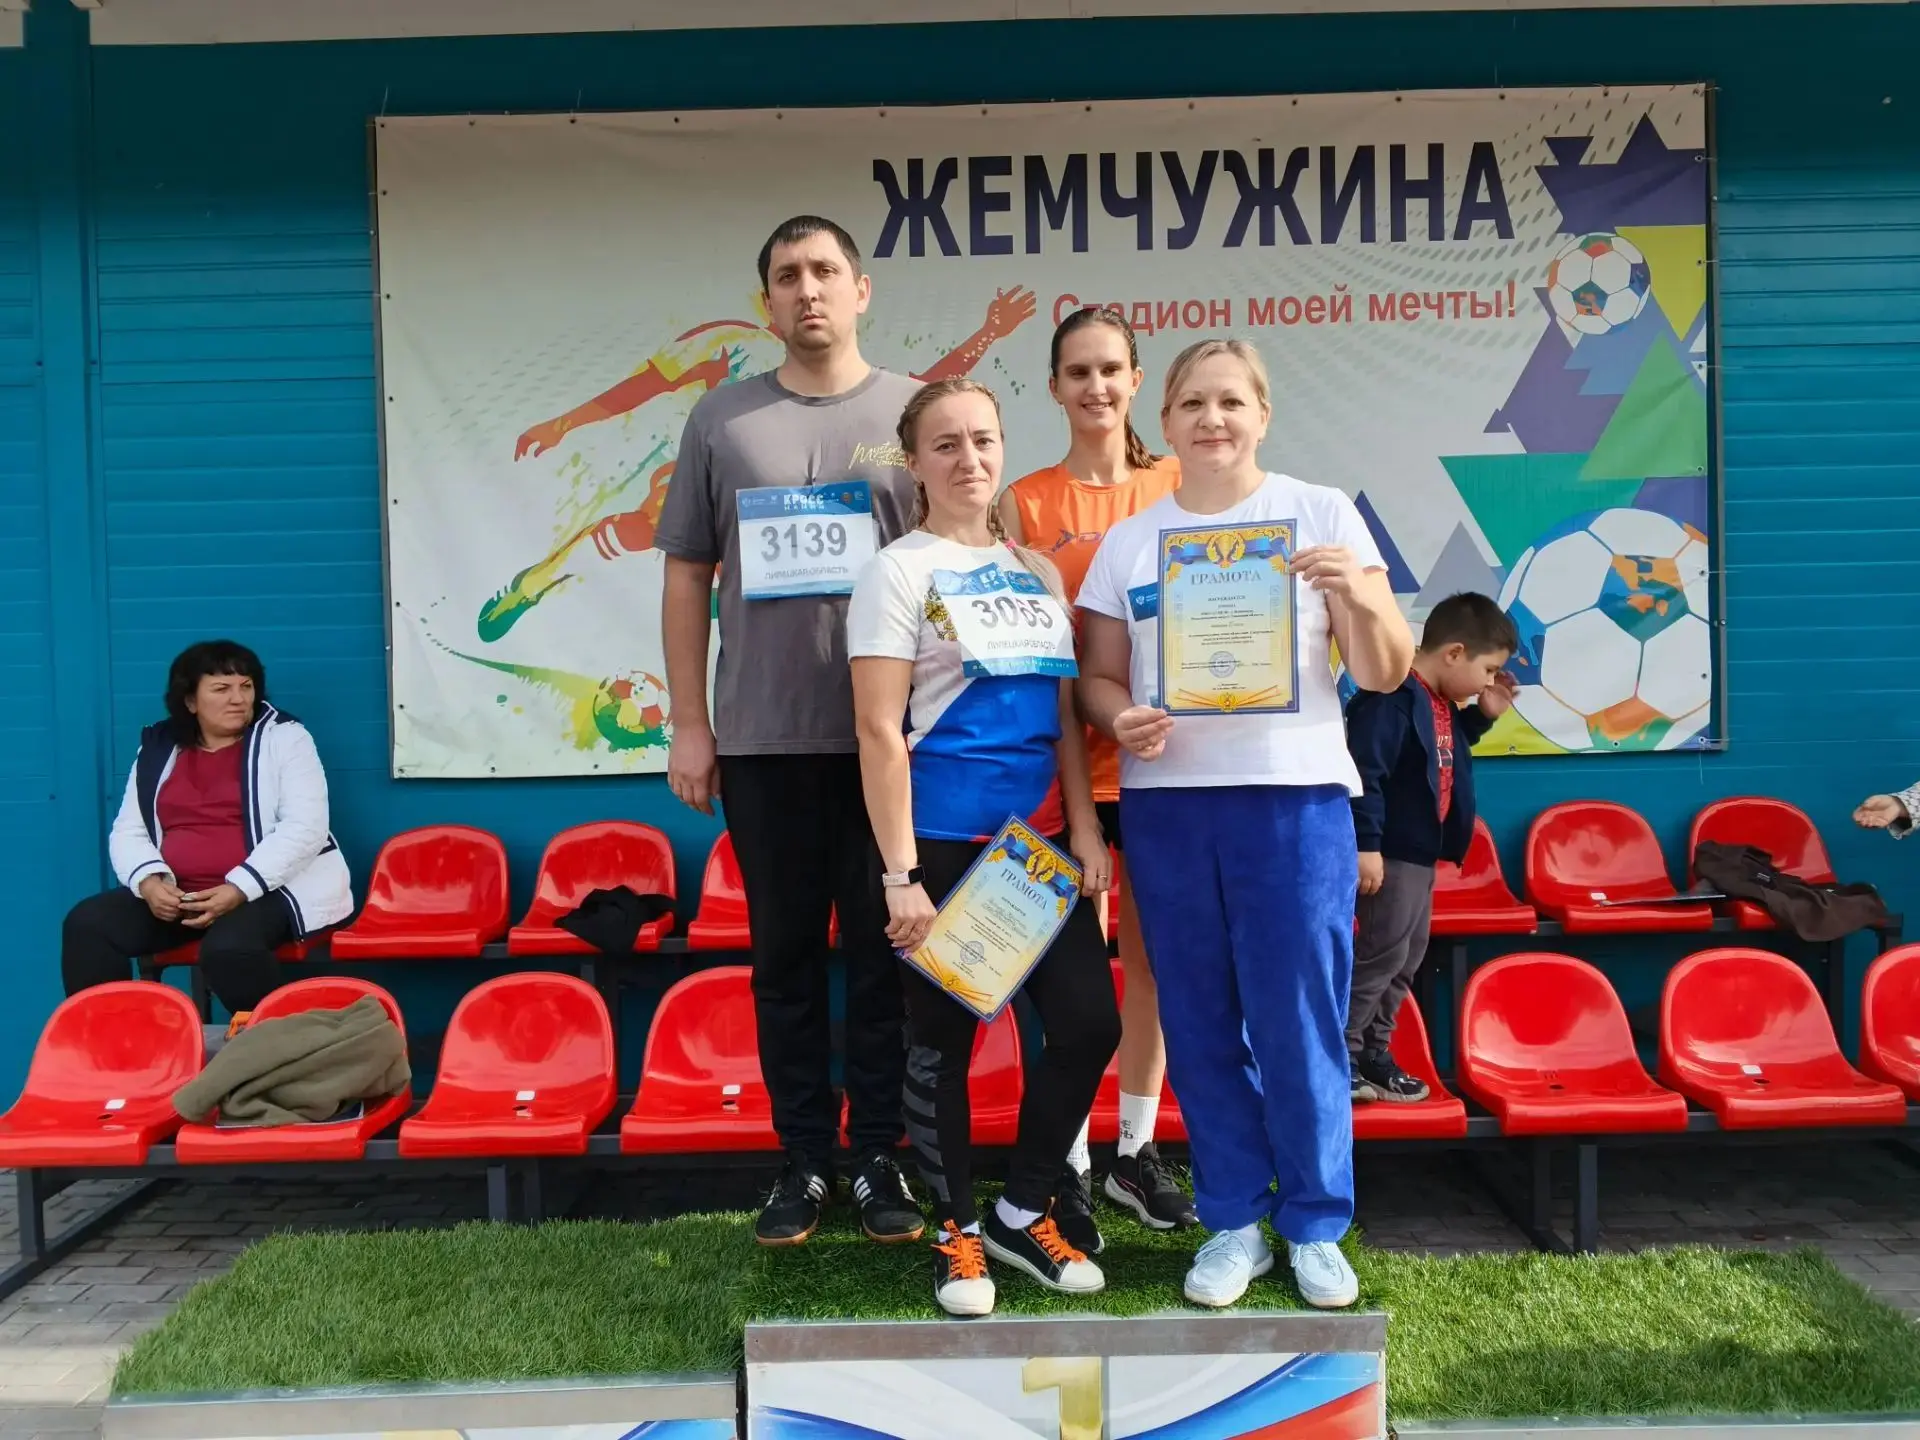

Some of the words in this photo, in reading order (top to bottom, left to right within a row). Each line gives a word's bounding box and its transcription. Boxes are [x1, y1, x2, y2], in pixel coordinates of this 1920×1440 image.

[873, 141, 1515, 258] ЖЕМЧУЖИНА
[1248, 283, 1352, 327] моей
[1369, 279, 1516, 322] мечты!
[783, 494, 824, 505] КРОСС
[761, 522, 847, 562] 3139
[1191, 570, 1262, 586] ГРАМОТА
[971, 596, 1054, 629] 3065
[1000, 868, 1049, 911] ГРАМОТА
[1022, 1356, 1104, 1440] 1
